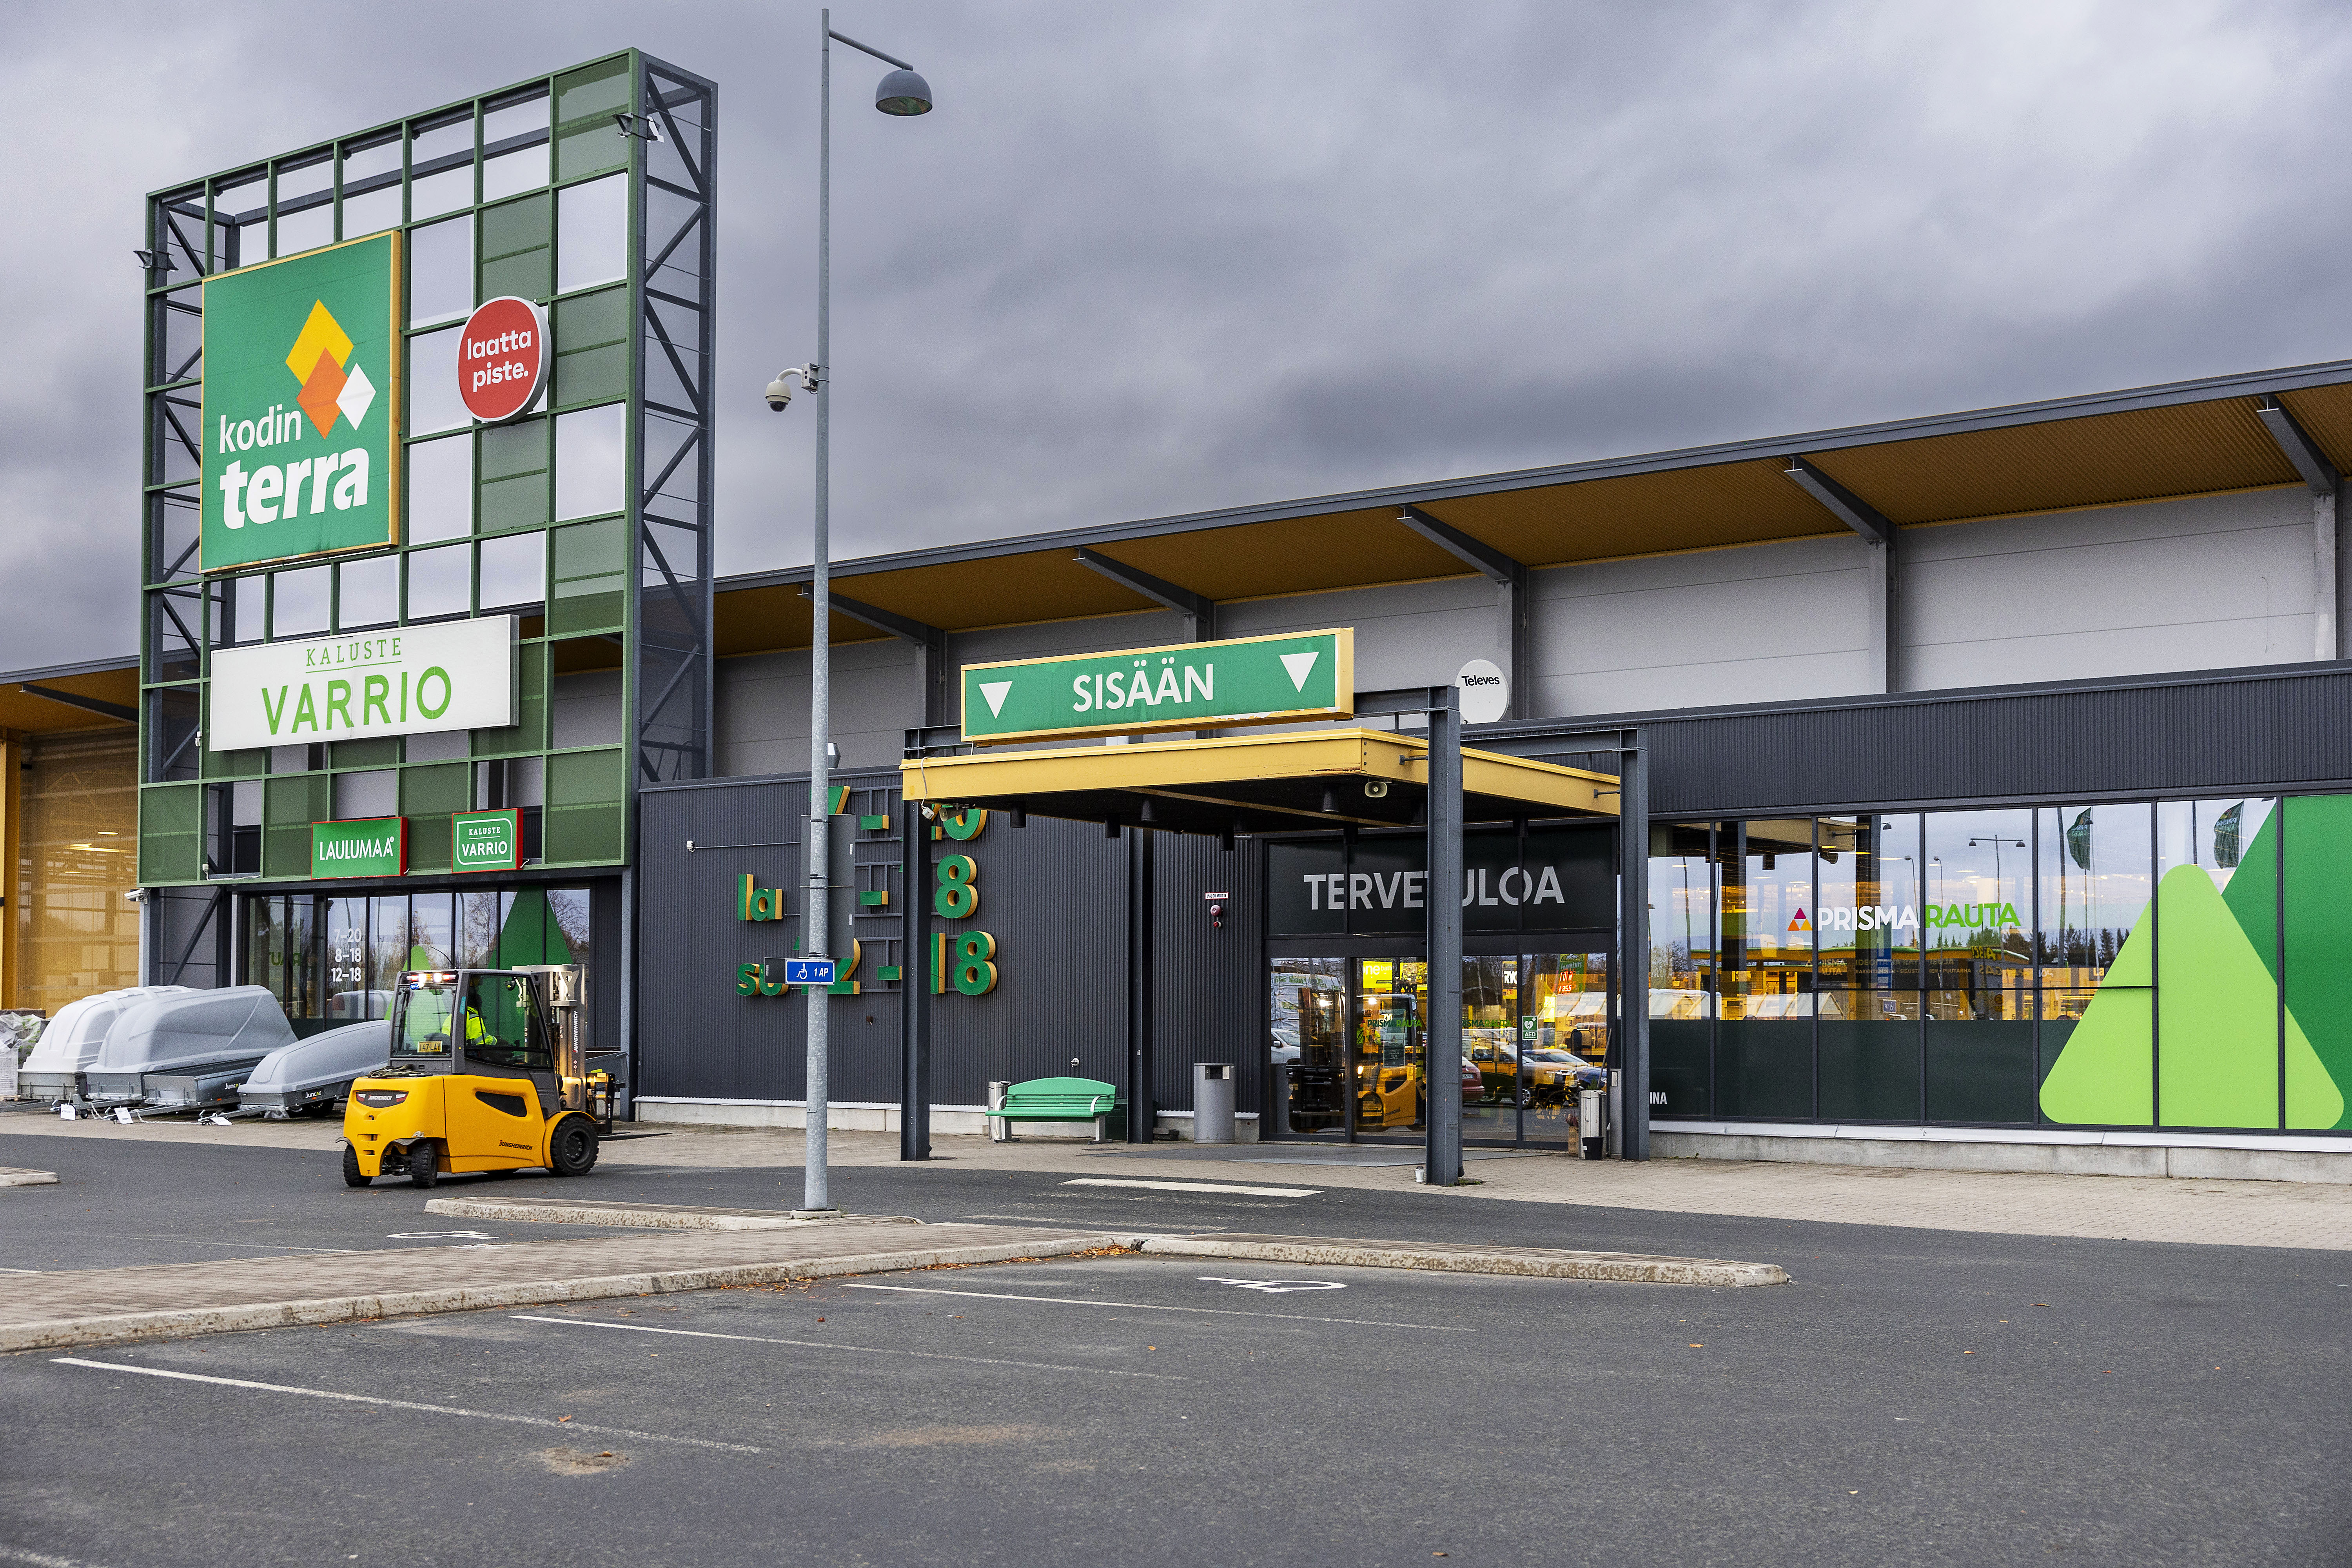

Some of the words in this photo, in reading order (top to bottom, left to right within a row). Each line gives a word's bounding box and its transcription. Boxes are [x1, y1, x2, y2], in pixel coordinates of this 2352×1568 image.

[467, 329, 532, 360] laatta
[472, 361, 529, 393] piste.
[219, 404, 301, 454] kodin
[219, 447, 369, 530] terra
[307, 637, 402, 667] KALUSTE
[1073, 657, 1213, 712] SISÄÄN
[1461, 675, 1500, 686] Televes
[261, 666, 452, 735] VARRIO
[468, 827, 501, 836] KALUSTE
[319, 836, 394, 861] LAULUMAA
[462, 840, 508, 857] VARRIO
[737, 873, 783, 922] la
[1303, 866, 1565, 910] TERVELOA
[1817, 905, 1920, 931] PRISMA
[1925, 902, 2022, 928] RAUTA
[334, 928, 362, 943] 7-20
[335, 947, 362, 963] 8-18
[331, 967, 361, 982] 12-18
[819, 967, 829, 977] AP
[1363, 965, 1380, 975] ne
[1396, 1019, 1423, 1027] RAUTA
[499, 1139, 533, 1151] JUNGHEINRICH
